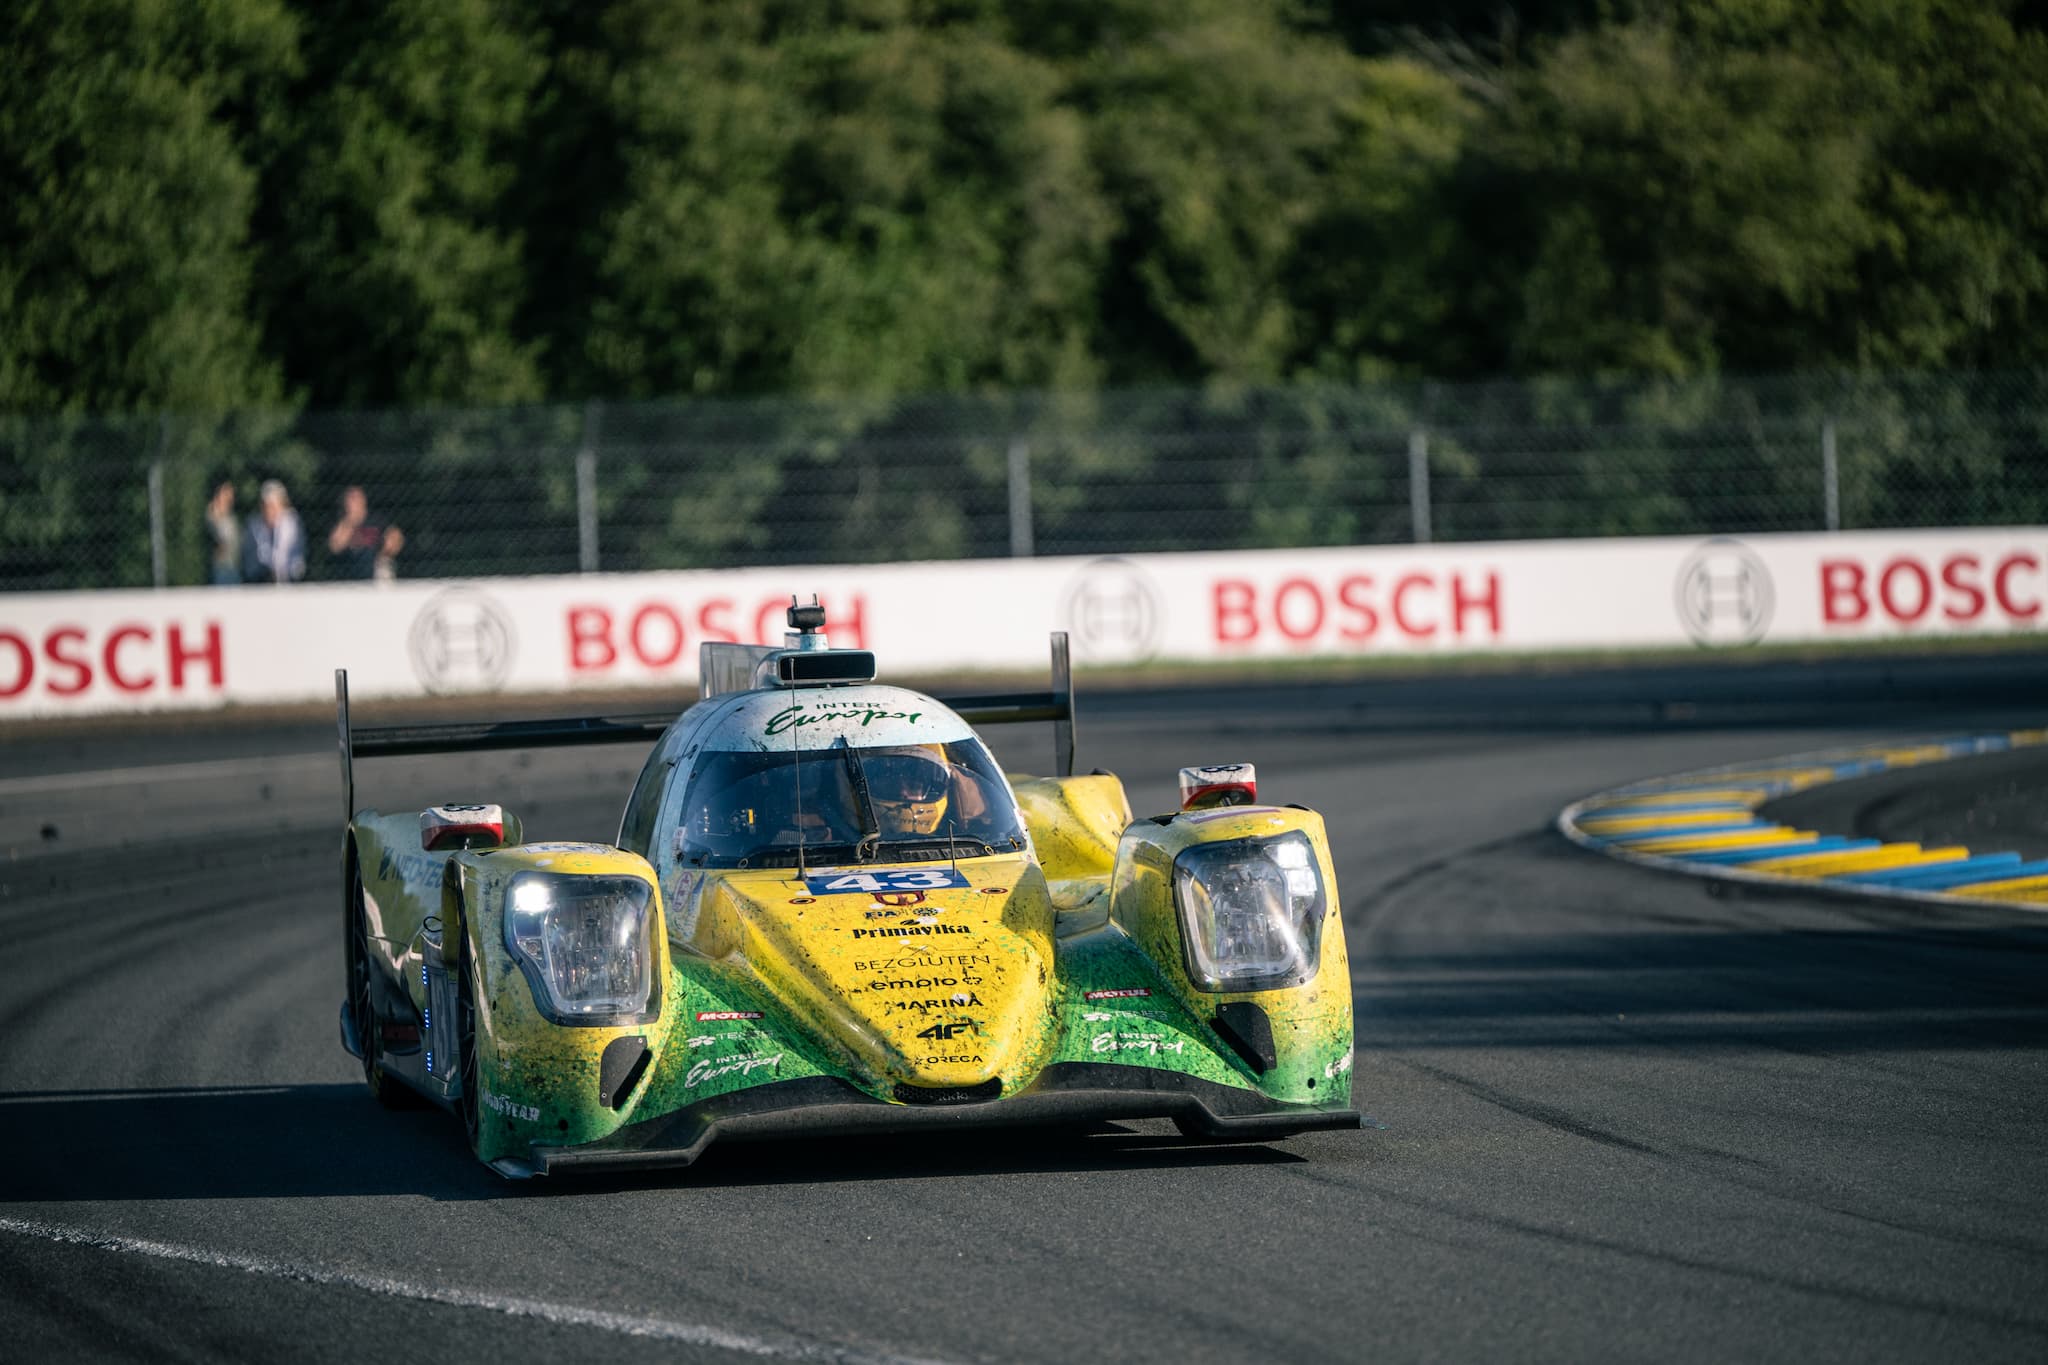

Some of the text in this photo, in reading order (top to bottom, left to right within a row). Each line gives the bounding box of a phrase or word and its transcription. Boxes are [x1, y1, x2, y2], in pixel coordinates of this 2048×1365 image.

[1211, 570, 1503, 644] BOSCH
[566, 592, 869, 670] BOSCH
[816, 702, 881, 710] INTER
[764, 705, 923, 736] Europol
[825, 871, 952, 890] 43
[852, 924, 971, 939] Primavika
[854, 955, 990, 971] BEZGLUTEN
[870, 977, 958, 991] emplo
[1087, 989, 1149, 999] MOTUL
[699, 1012, 762, 1021] MOTUL
[926, 1055, 984, 1064] ORECA
